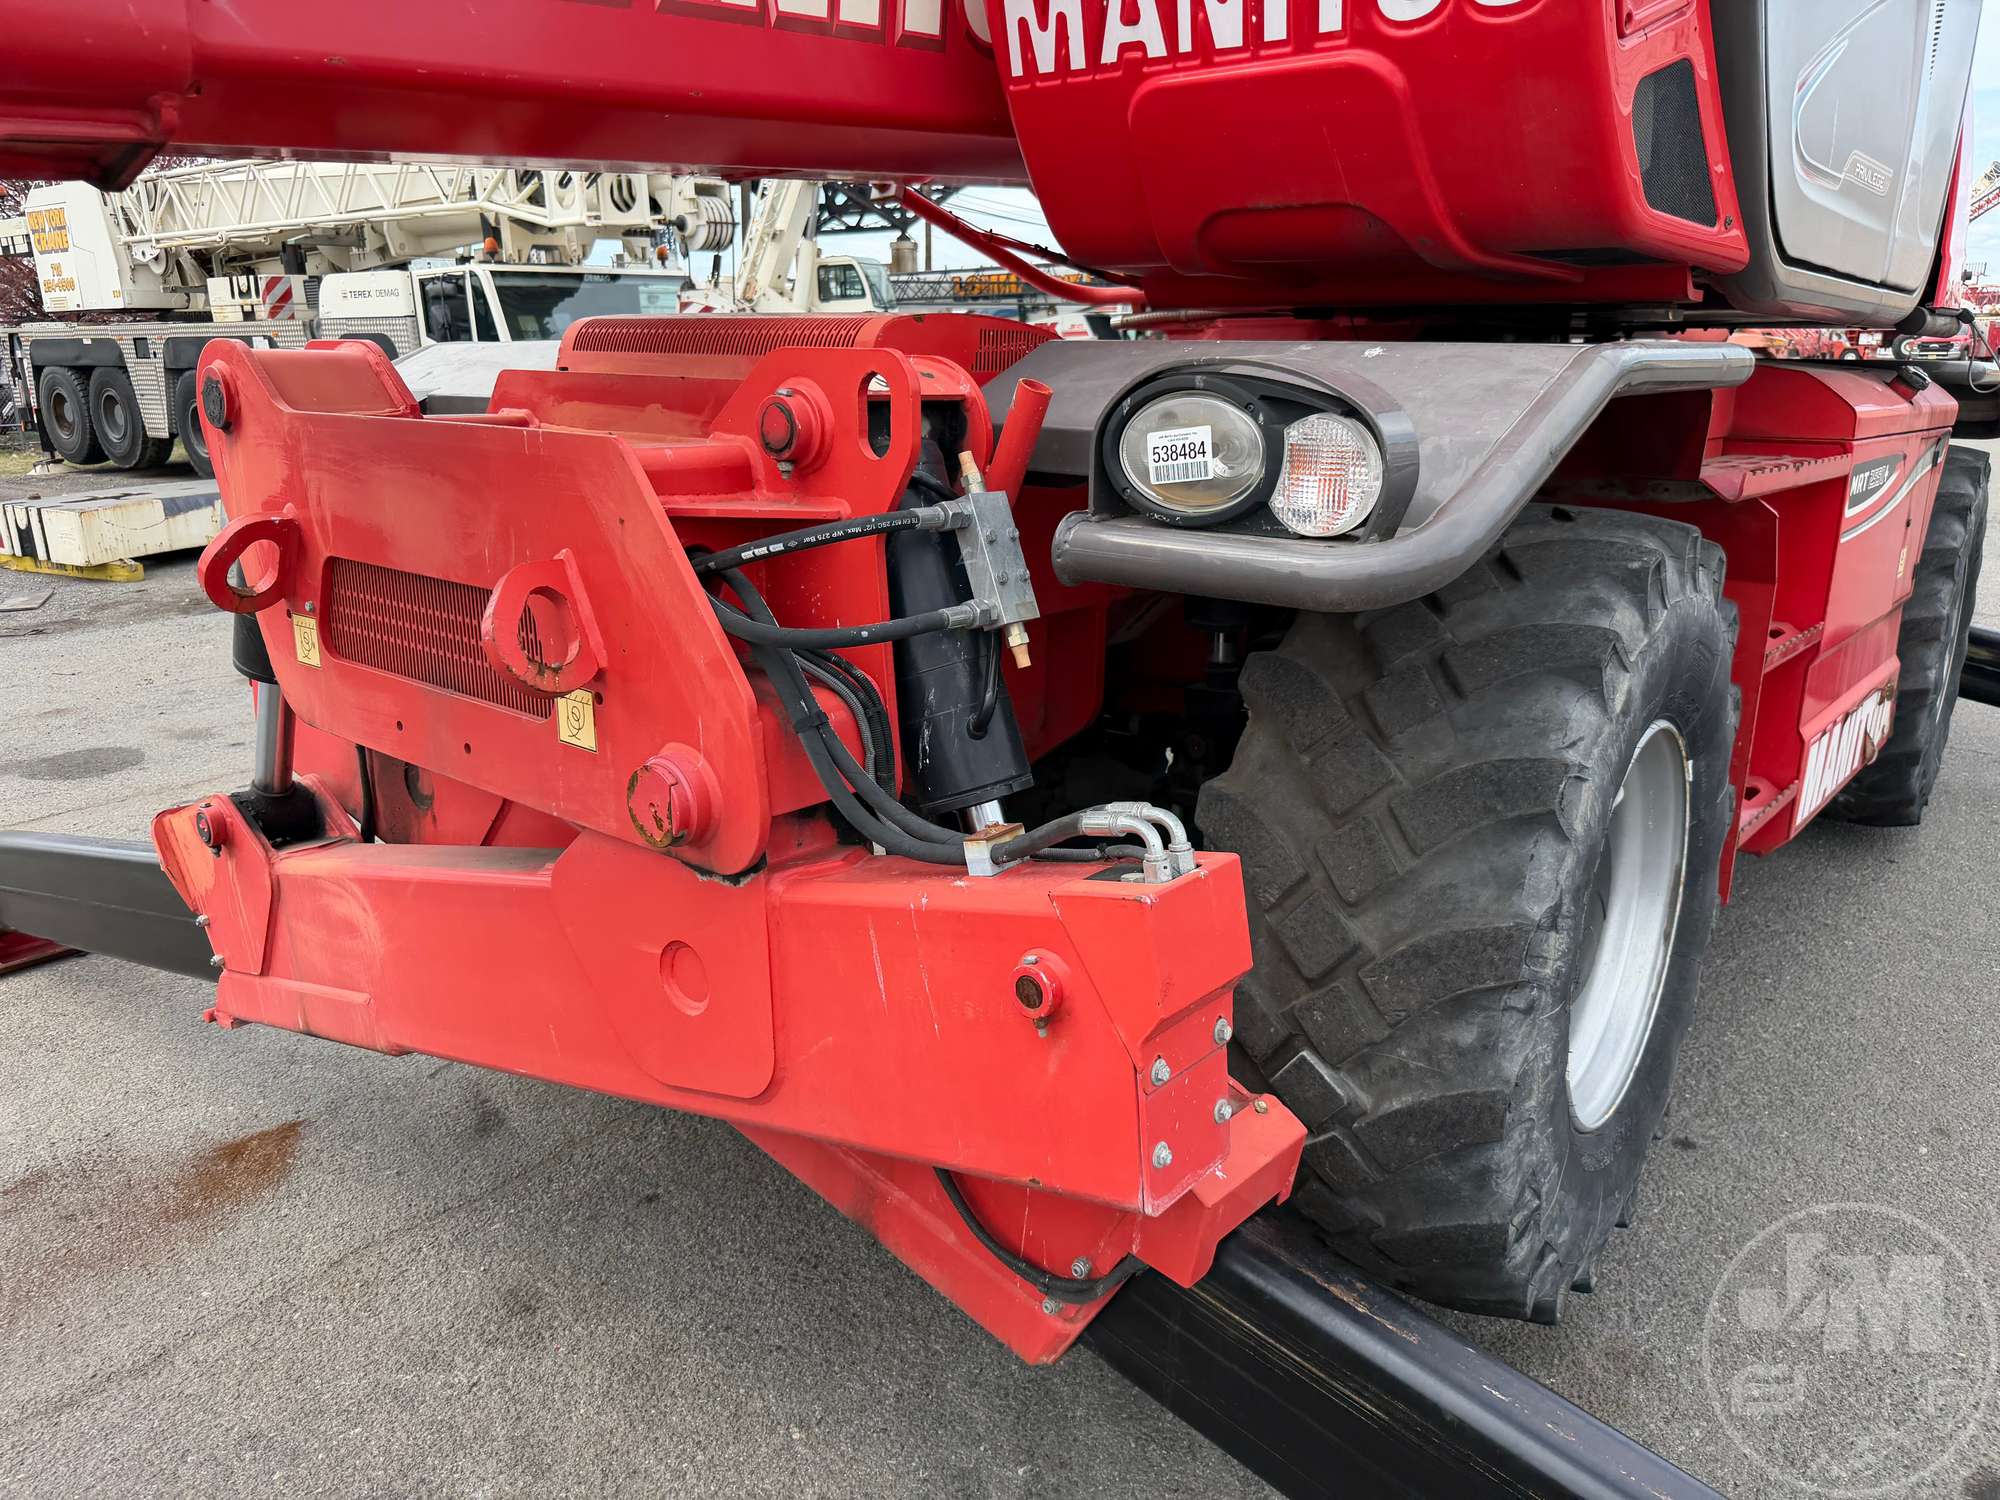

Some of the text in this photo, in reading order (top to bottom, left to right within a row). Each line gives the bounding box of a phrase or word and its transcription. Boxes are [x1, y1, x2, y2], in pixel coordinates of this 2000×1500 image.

[27, 207, 66, 231] NEW YORK
[34, 229, 70, 253] CRANE
[348, 288, 400, 299] TEREX DEMAG
[1152, 440, 1207, 464] 538484
[1849, 471, 1870, 497] MRT
[831, 530, 845, 538] WP
